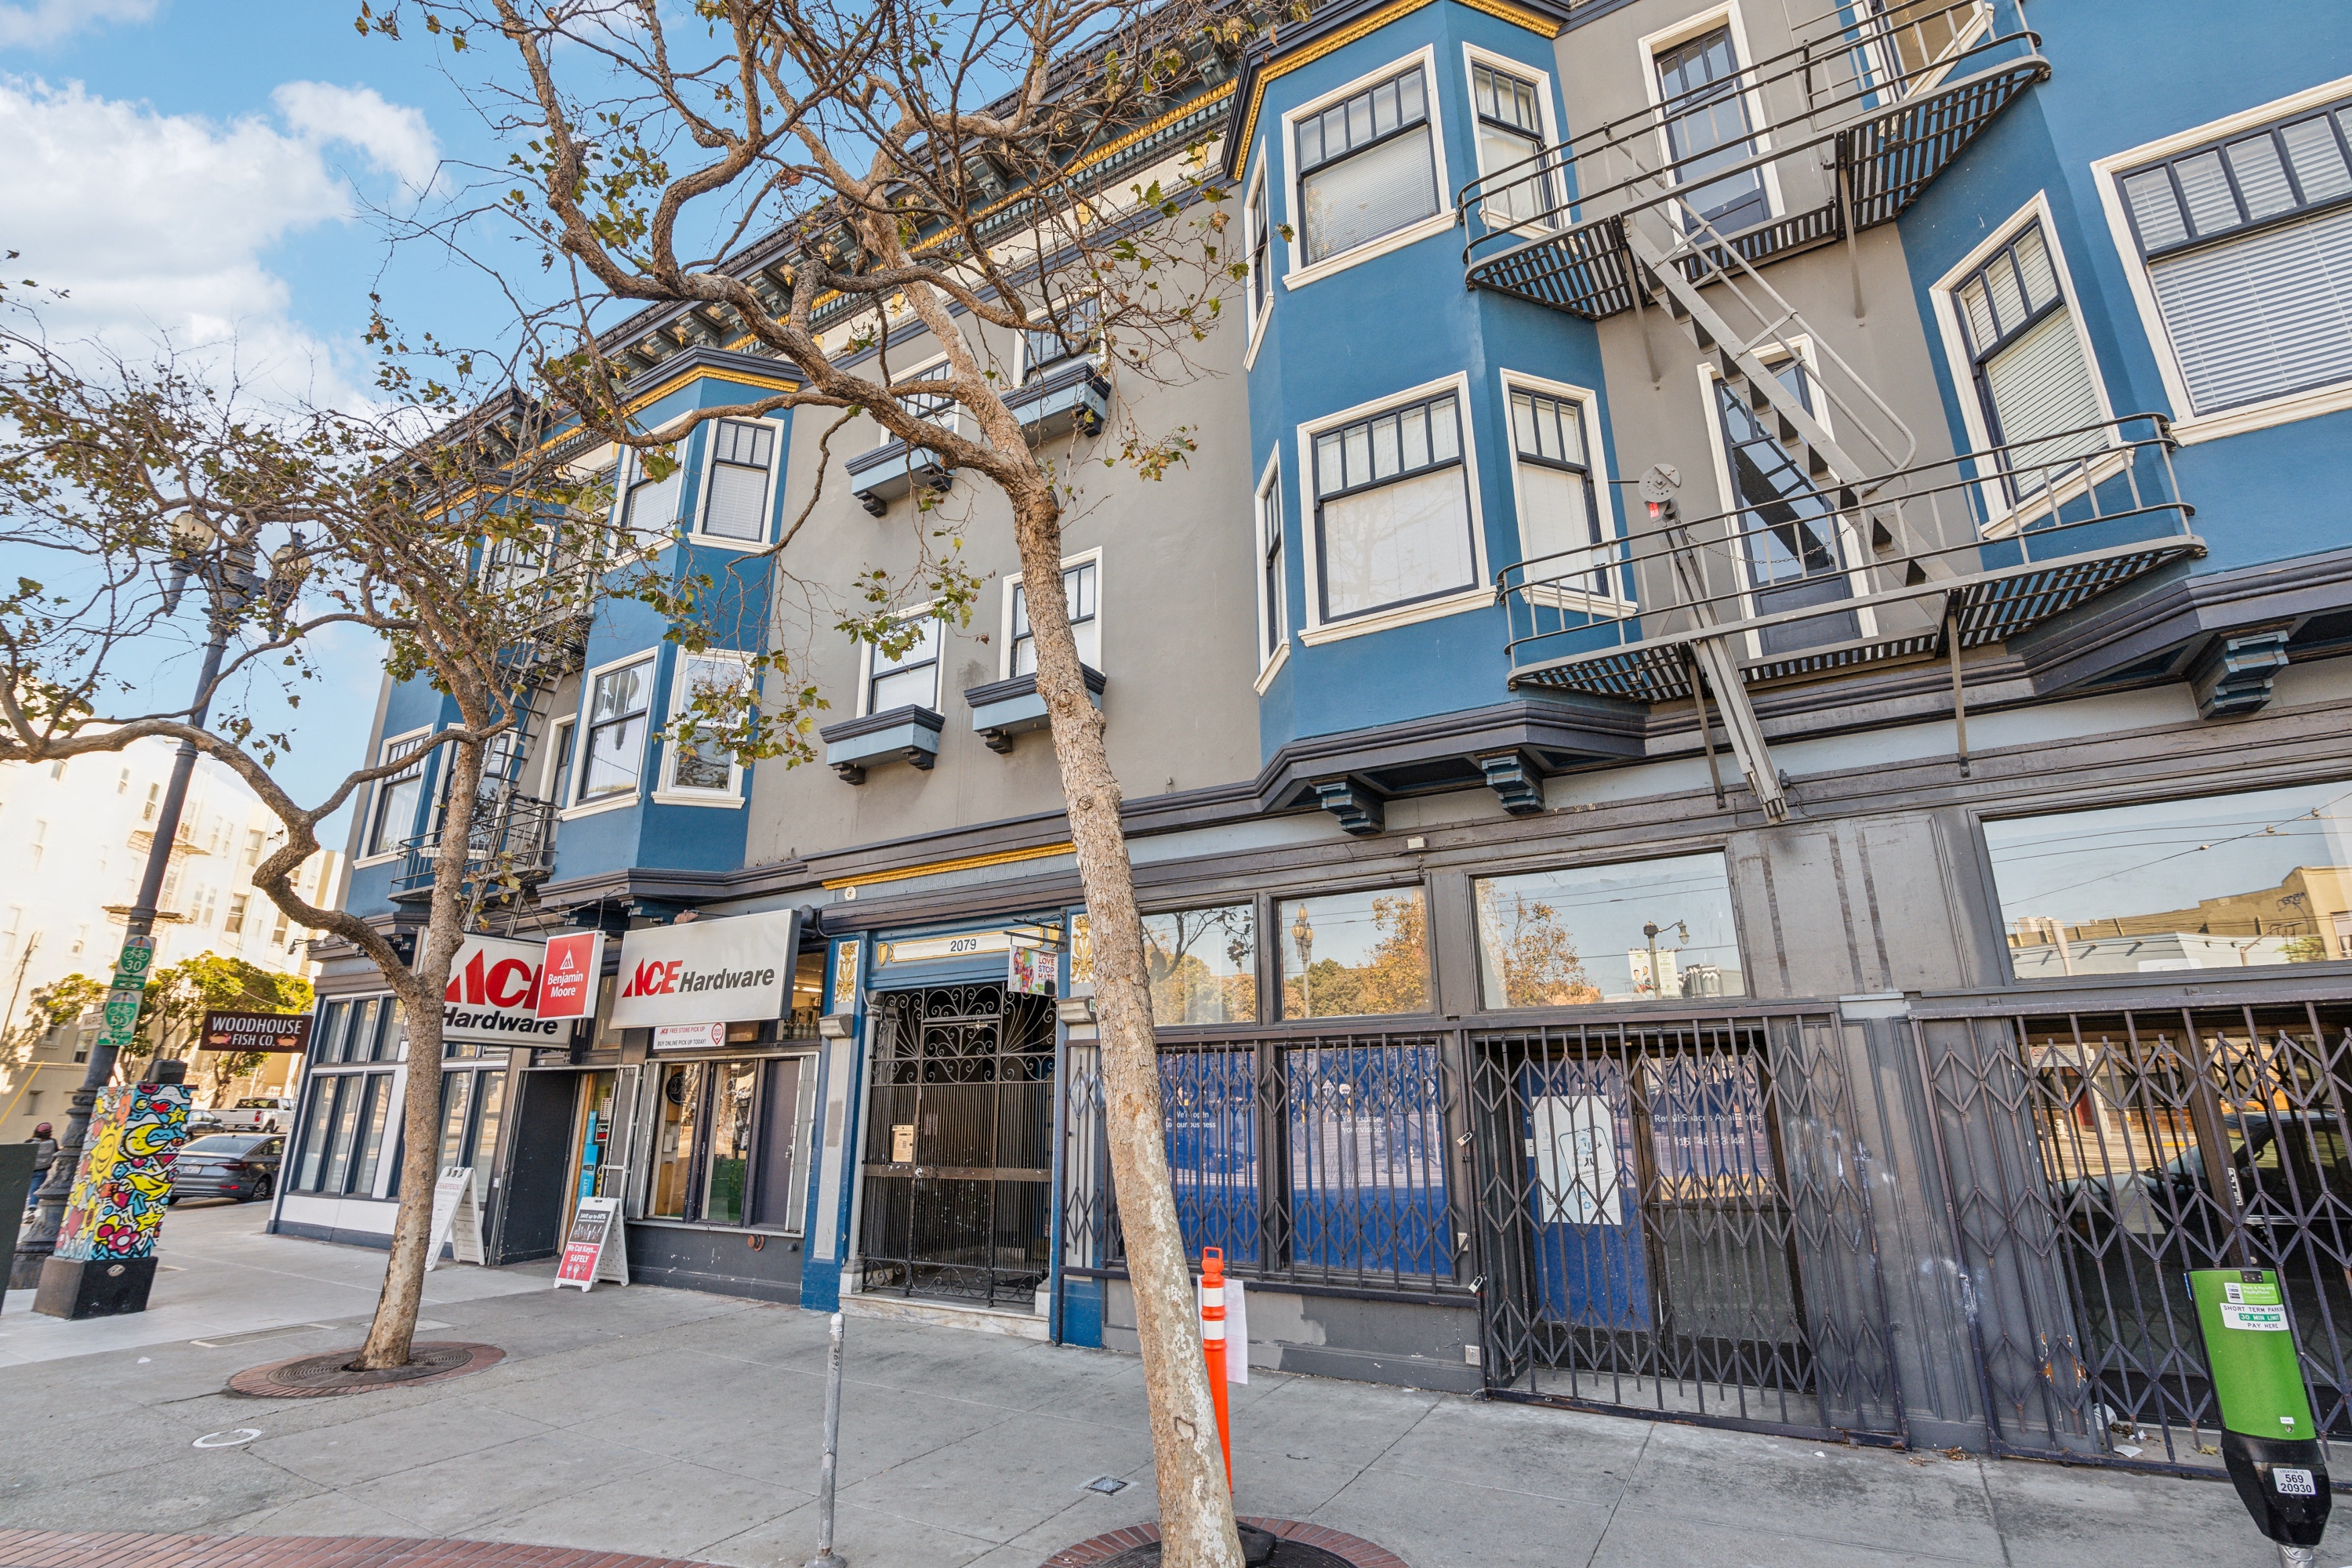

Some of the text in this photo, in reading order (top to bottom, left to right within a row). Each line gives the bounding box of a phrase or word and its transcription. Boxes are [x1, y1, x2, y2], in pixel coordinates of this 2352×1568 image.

[950, 938, 976, 952] 2079
[125, 960, 142, 971] 30
[1038, 957, 1054, 966] LOVE
[547, 970, 583, 986] Benjamin
[622, 957, 775, 998] ACE Hardware
[550, 986, 576, 998] Moore
[110, 1016, 129, 1026] 50
[212, 1017, 303, 1034] WOODHOUSE
[443, 1006, 558, 1035] Hardware
[231, 1034, 275, 1046] FISH CO.
[569, 1254, 590, 1263] SAFELY
[2285, 1474, 2303, 1483] 569
[2280, 1483, 2311, 1493] 20930
